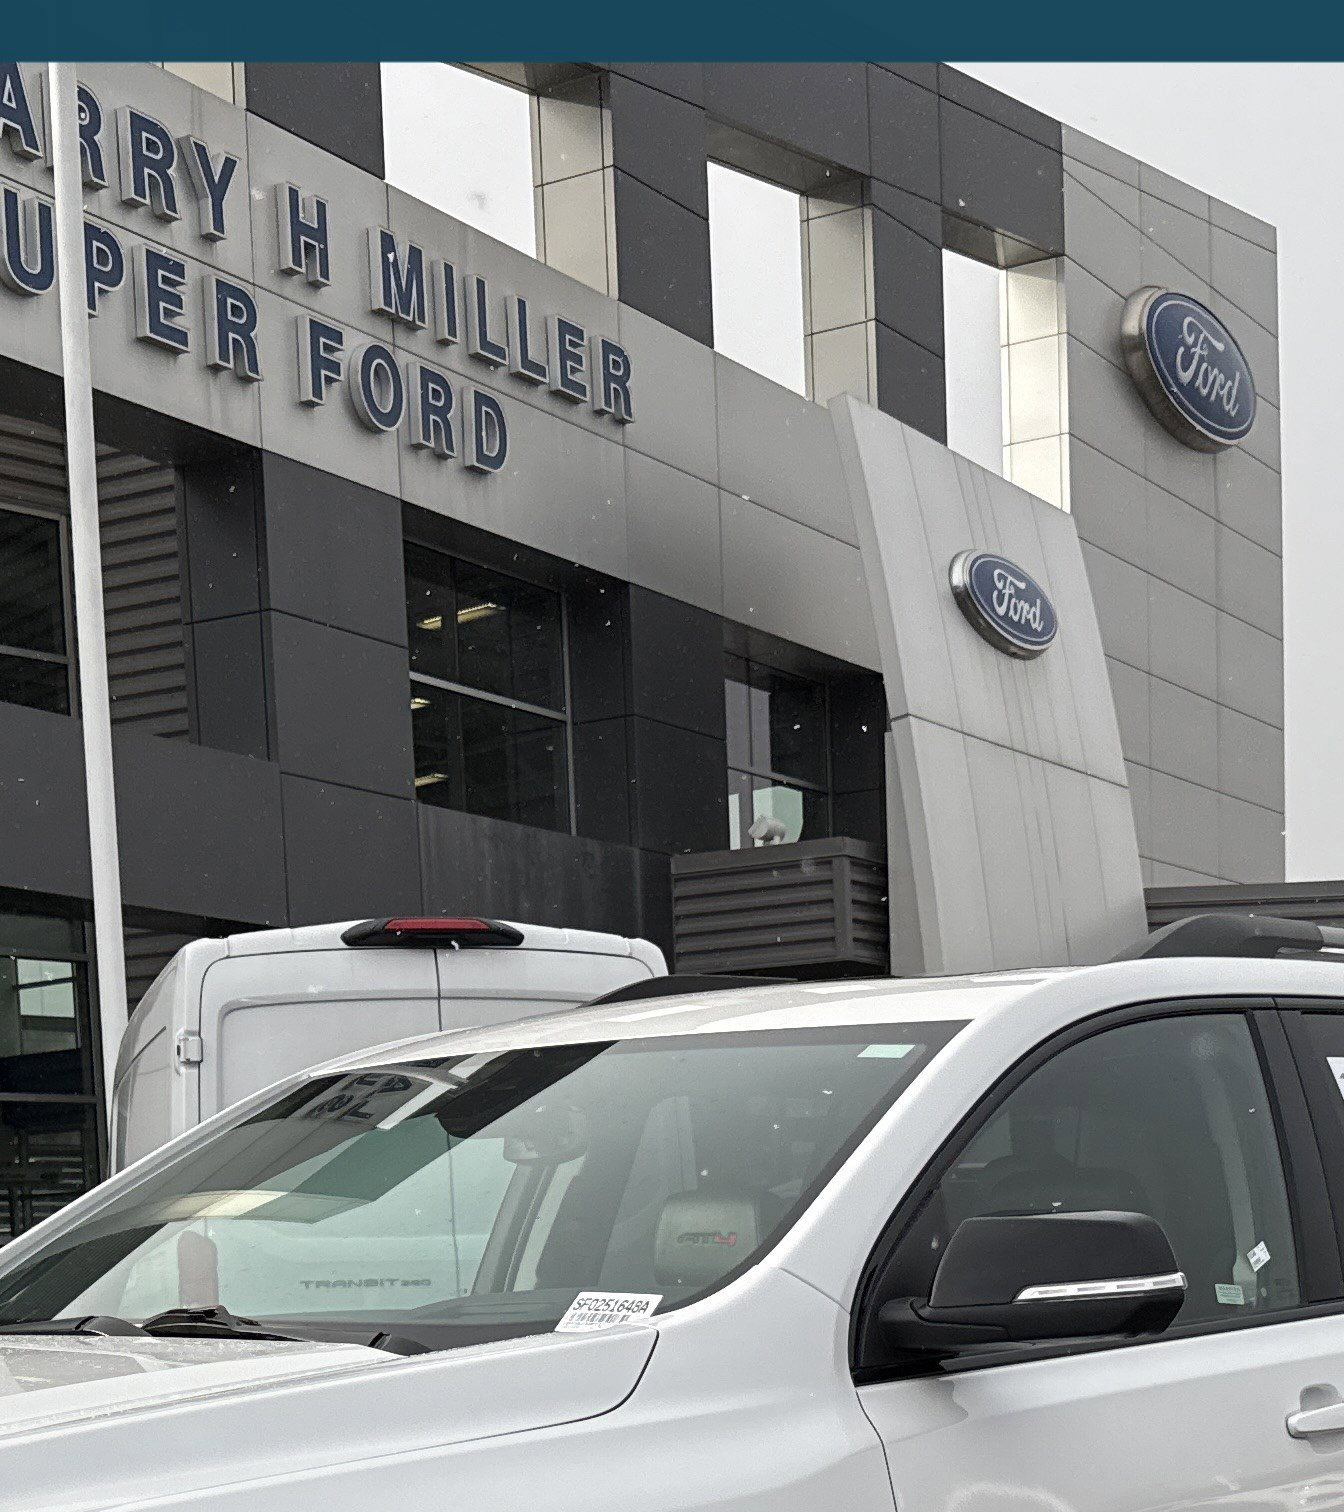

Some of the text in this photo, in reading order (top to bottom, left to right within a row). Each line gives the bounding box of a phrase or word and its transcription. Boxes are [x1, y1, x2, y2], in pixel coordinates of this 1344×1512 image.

[278, 182, 332, 288] H
[369, 226, 636, 425] MILLER
[297, 314, 509, 474] FORD
[1176, 315, 1241, 417] Ford
[992, 568, 1044, 632] Ford
[300, 1278, 399, 1289] TRANSIT
